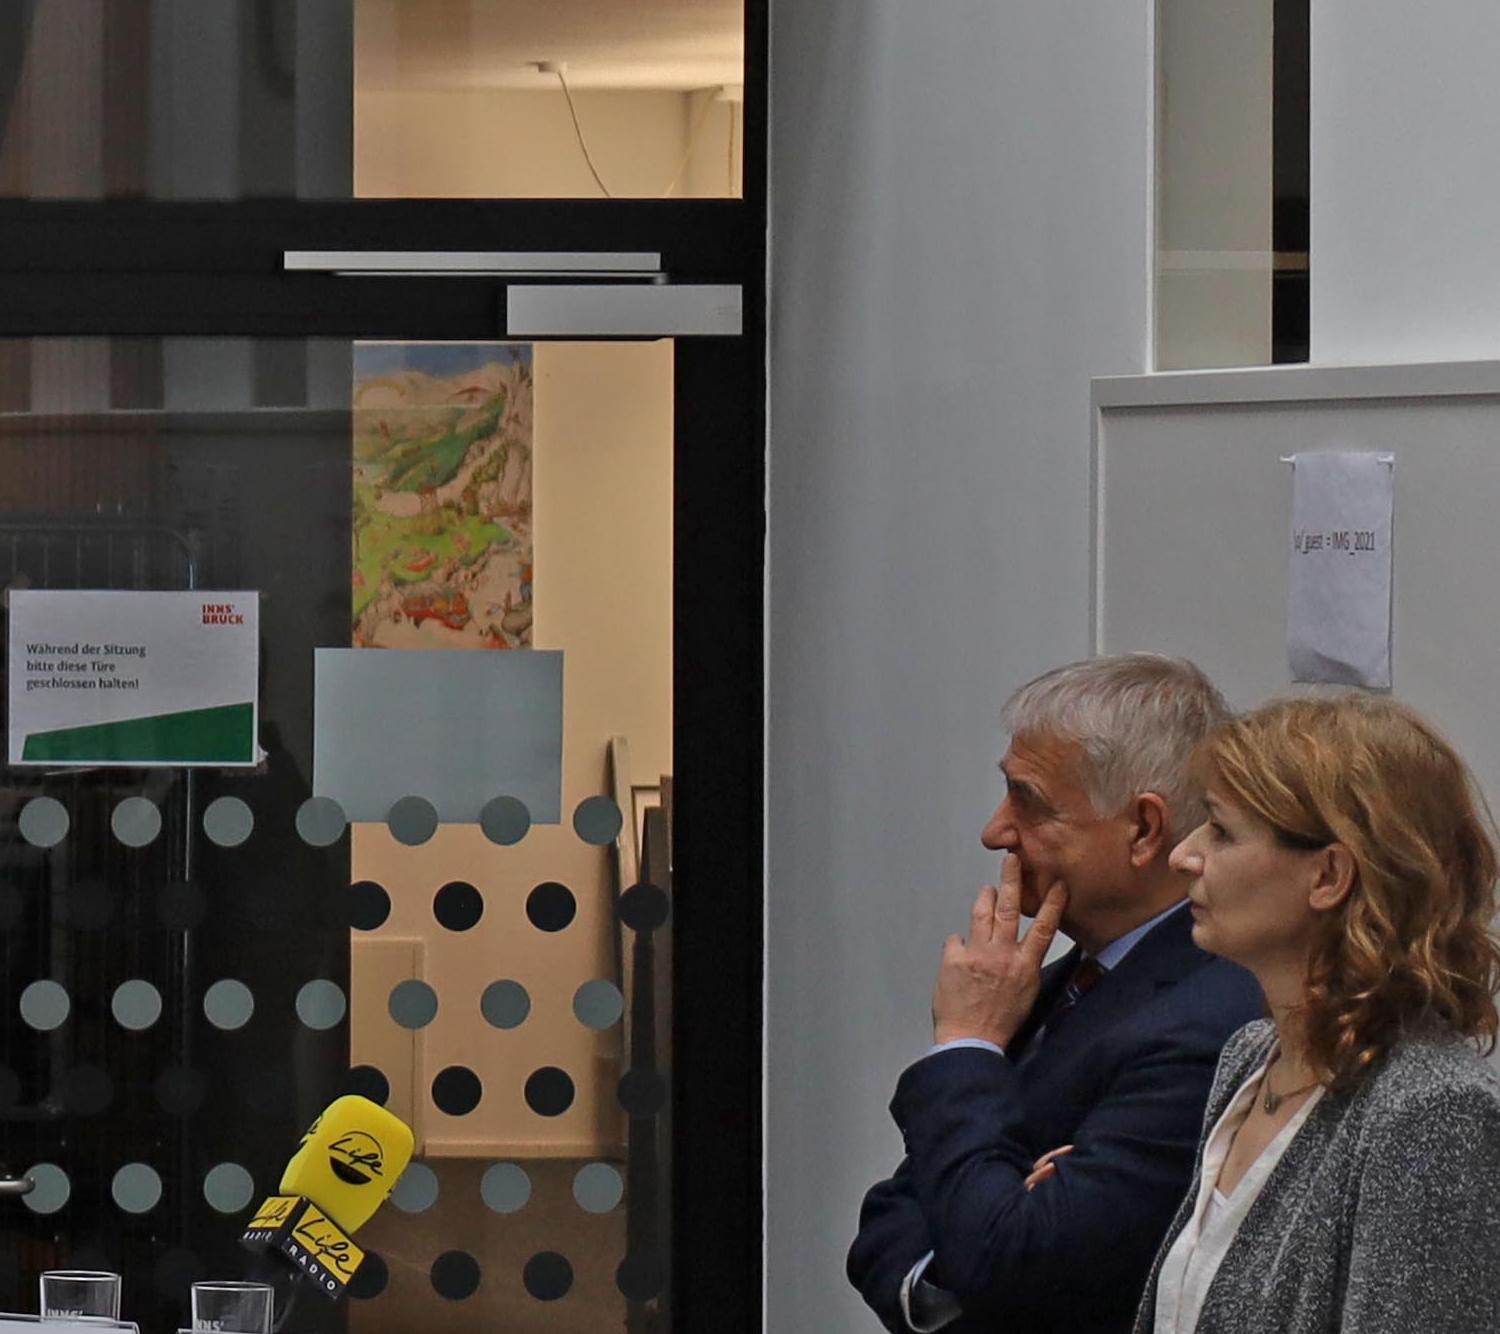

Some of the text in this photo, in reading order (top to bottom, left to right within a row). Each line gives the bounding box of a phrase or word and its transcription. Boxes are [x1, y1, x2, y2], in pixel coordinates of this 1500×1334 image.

[202, 614, 244, 625] BRUCK
[26, 643, 146, 658] Während der Sitzung
[26, 660, 116, 672] bitte diese Türe
[26, 678, 140, 691] geschlossen halten!
[328, 1137, 384, 1176] Life
[295, 1217, 354, 1276] Life
[289, 1244, 336, 1292] RADIO
